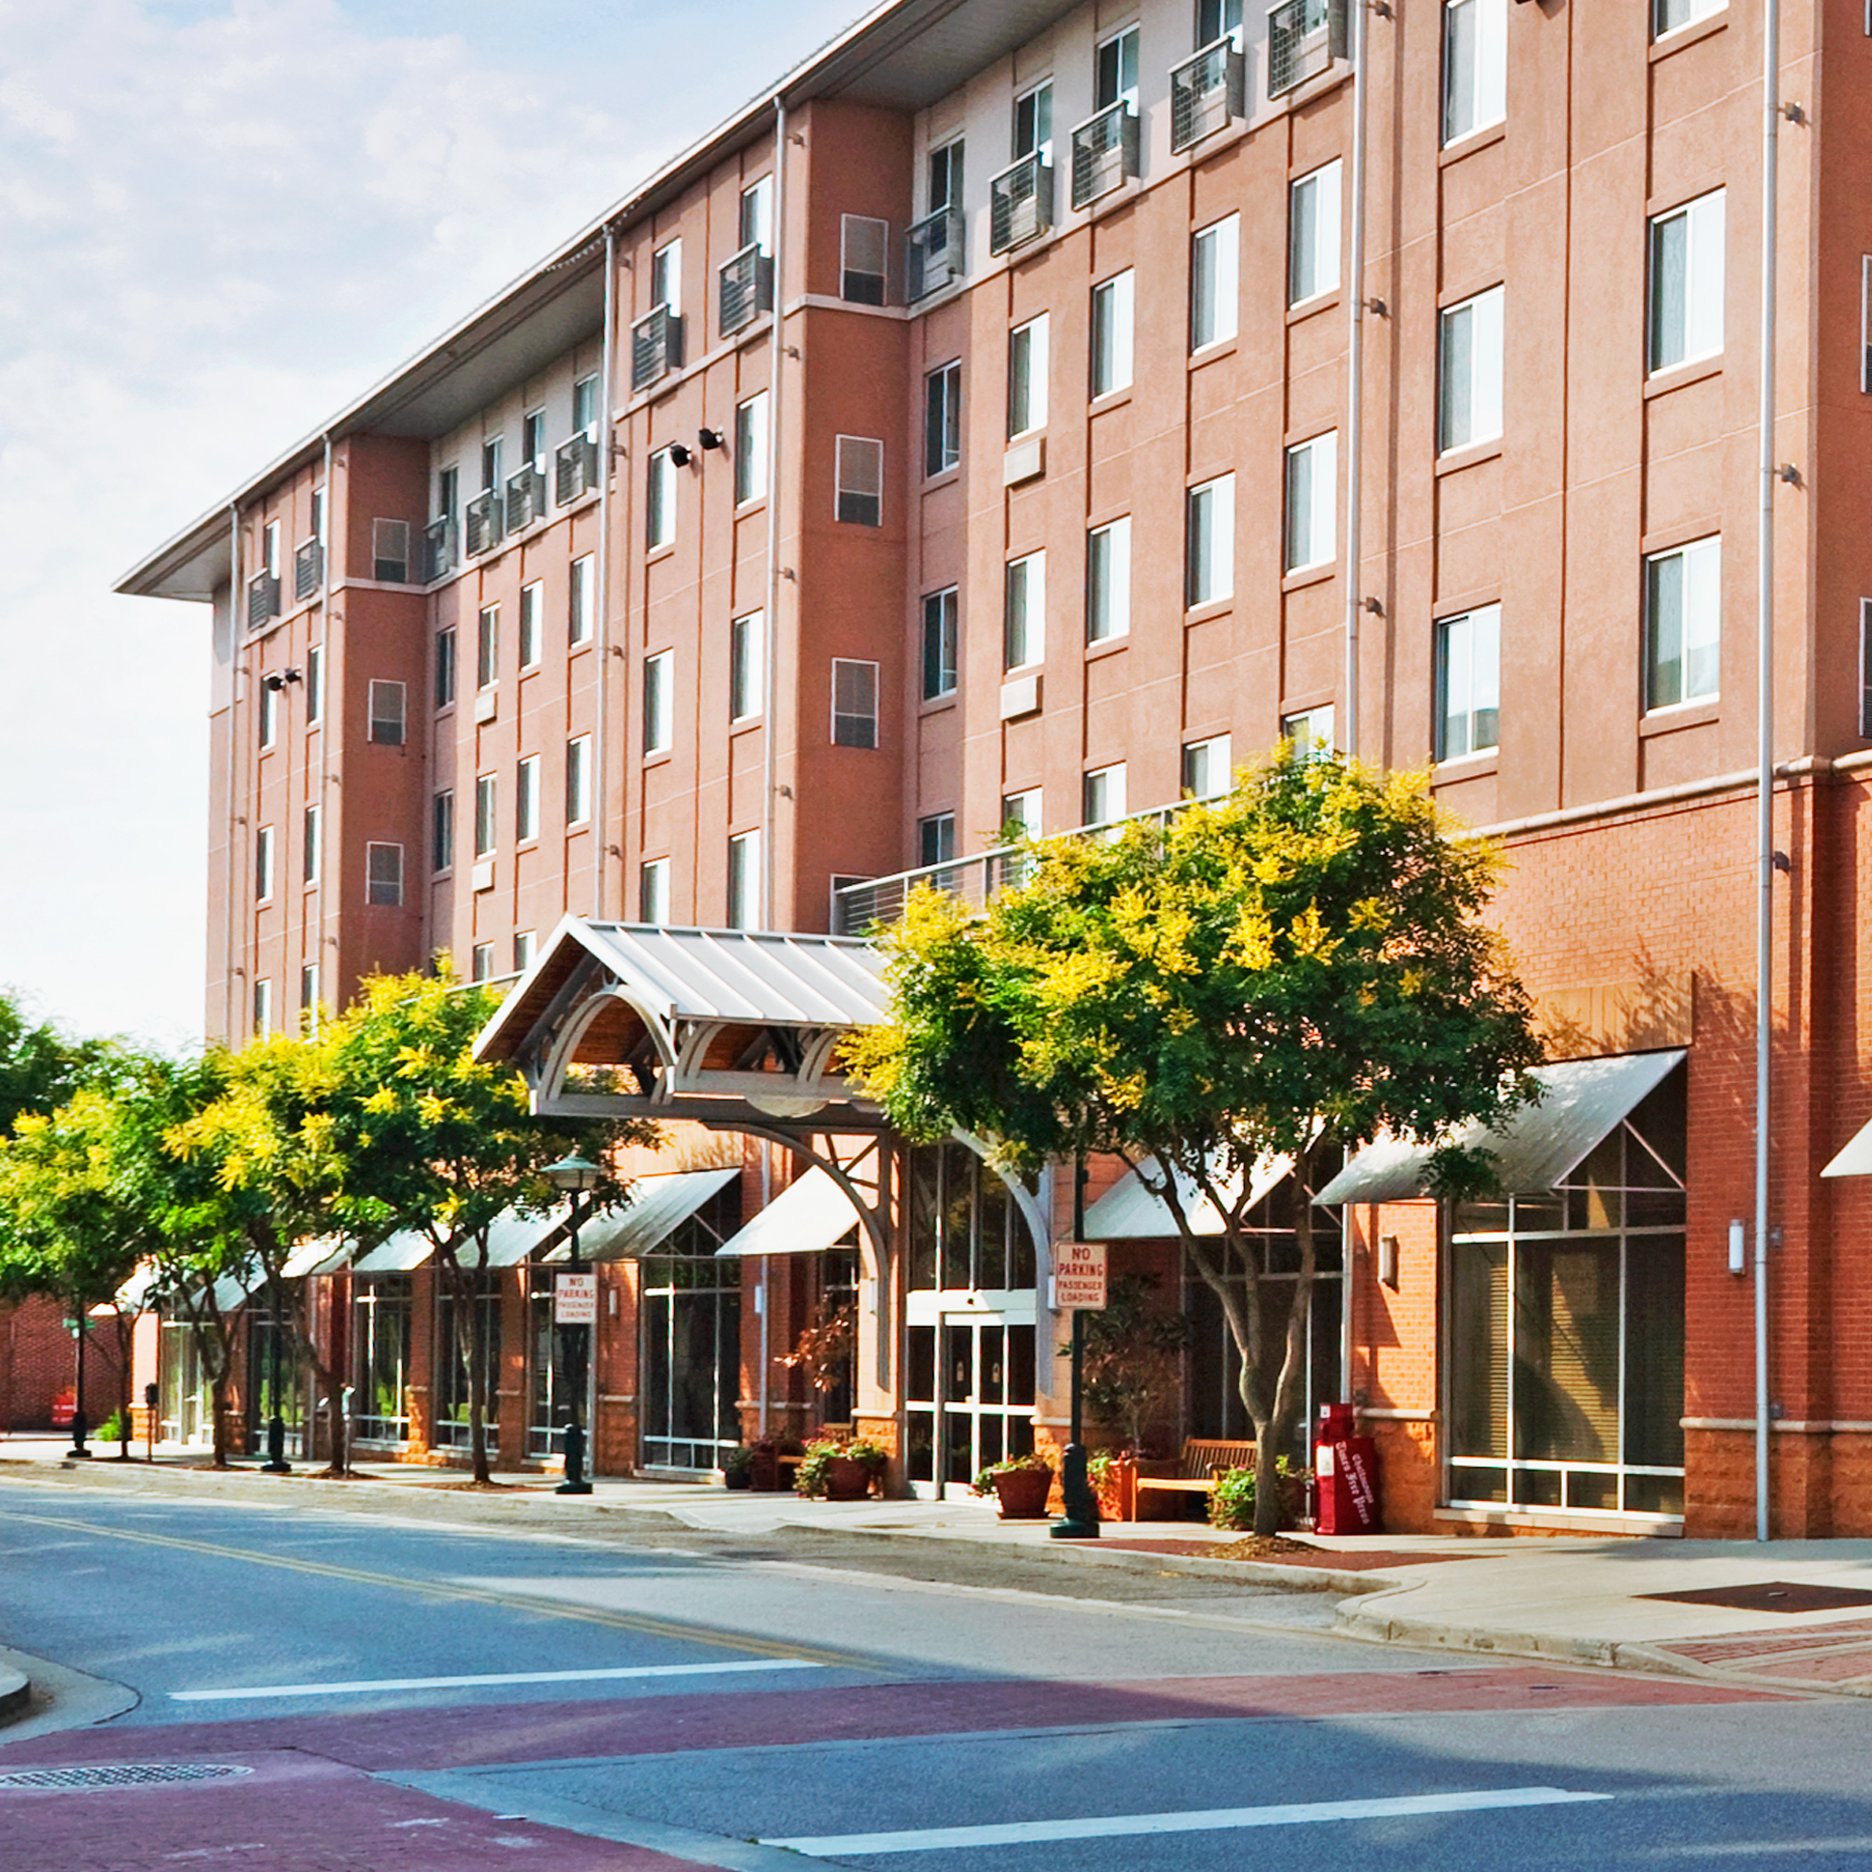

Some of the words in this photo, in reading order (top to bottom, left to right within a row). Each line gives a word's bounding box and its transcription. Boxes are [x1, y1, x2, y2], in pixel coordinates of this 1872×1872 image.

[1072, 1247, 1091, 1261] NO
[1058, 1263, 1104, 1276] PARKING
[569, 1278, 584, 1287] NO
[559, 1289, 594, 1299] PARKING
[1061, 1291, 1100, 1302] LOADING
[1335, 1440, 1352, 1472] Times
